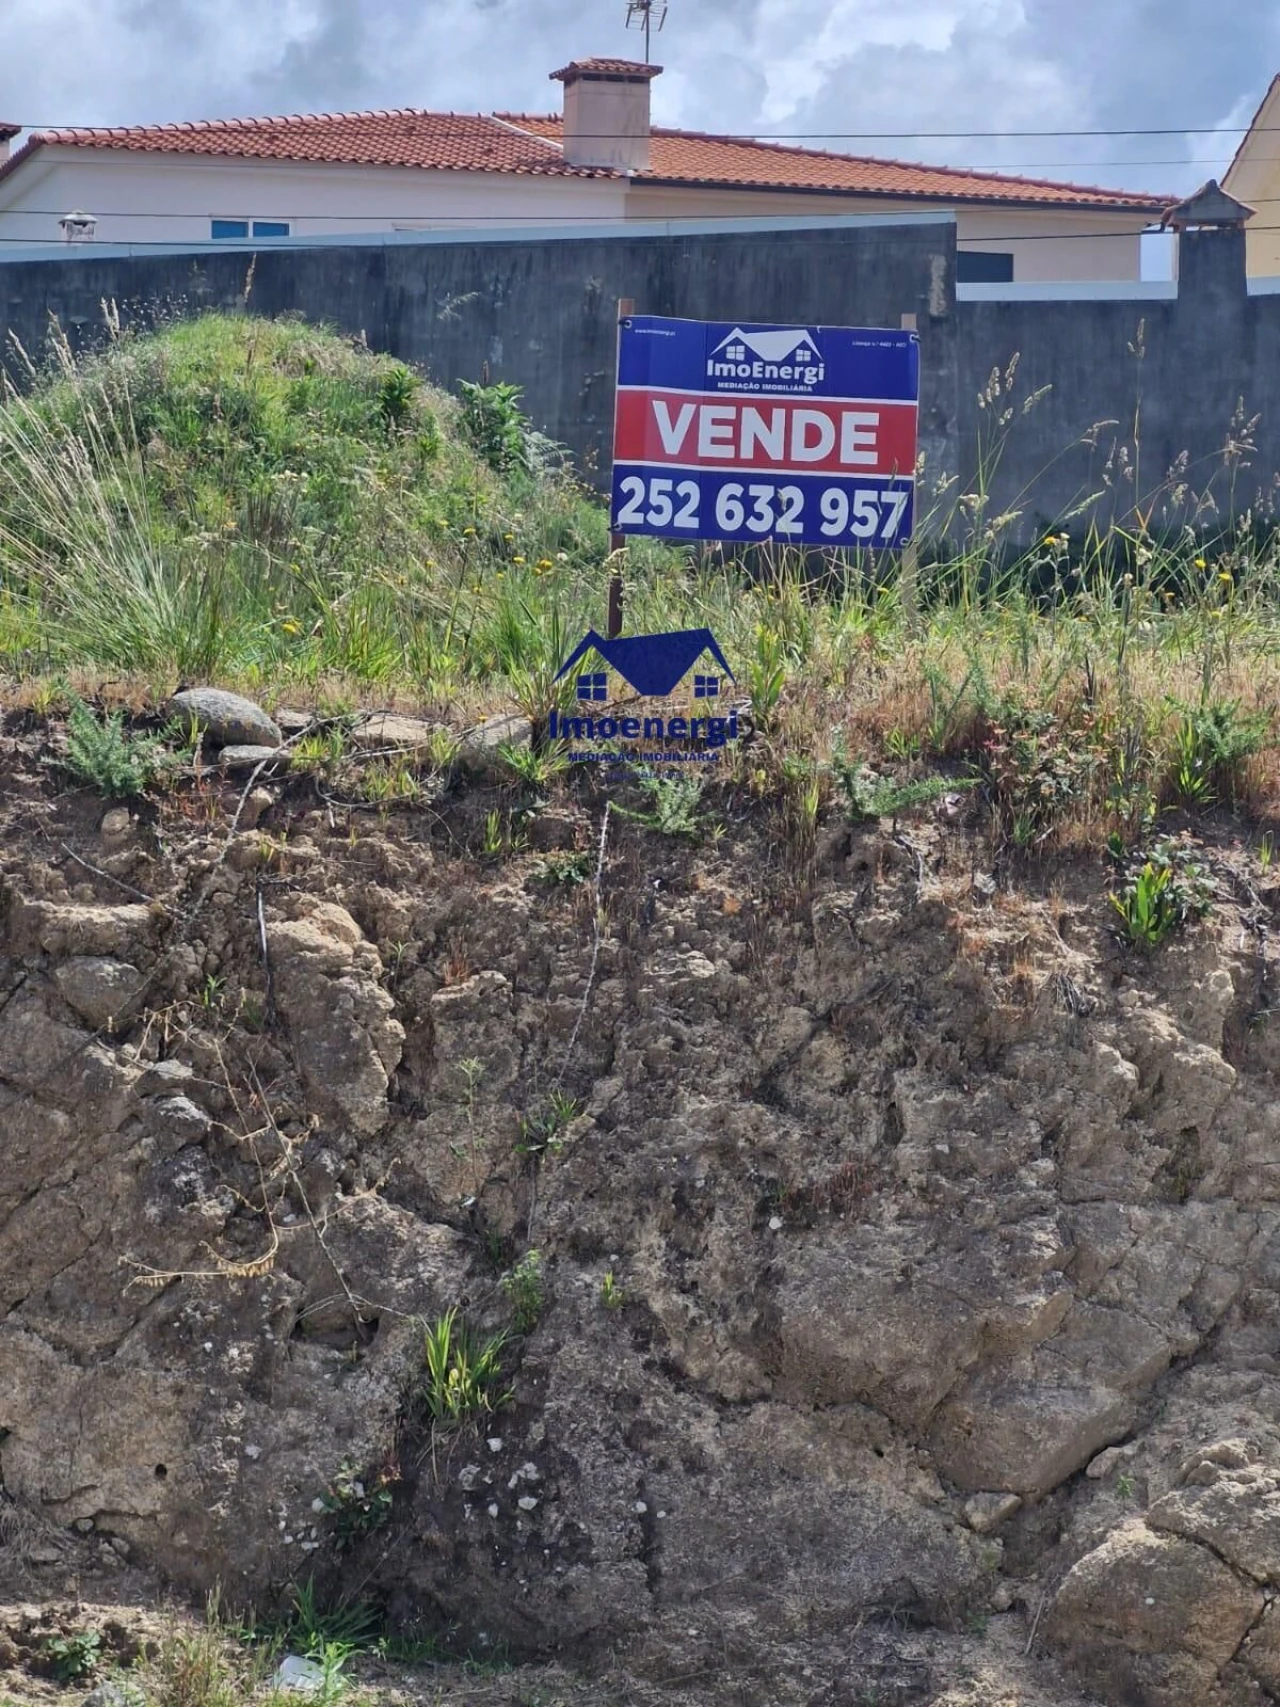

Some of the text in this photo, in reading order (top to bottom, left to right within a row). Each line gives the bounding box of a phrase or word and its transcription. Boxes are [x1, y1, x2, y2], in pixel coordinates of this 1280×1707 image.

[706, 359, 825, 385] ImoEnergi
[717, 381, 813, 393] MEDIAÇÃO IMOBILIÁRIA
[652, 400, 880, 465] VENDE
[617, 476, 909, 538] 252 632 957
